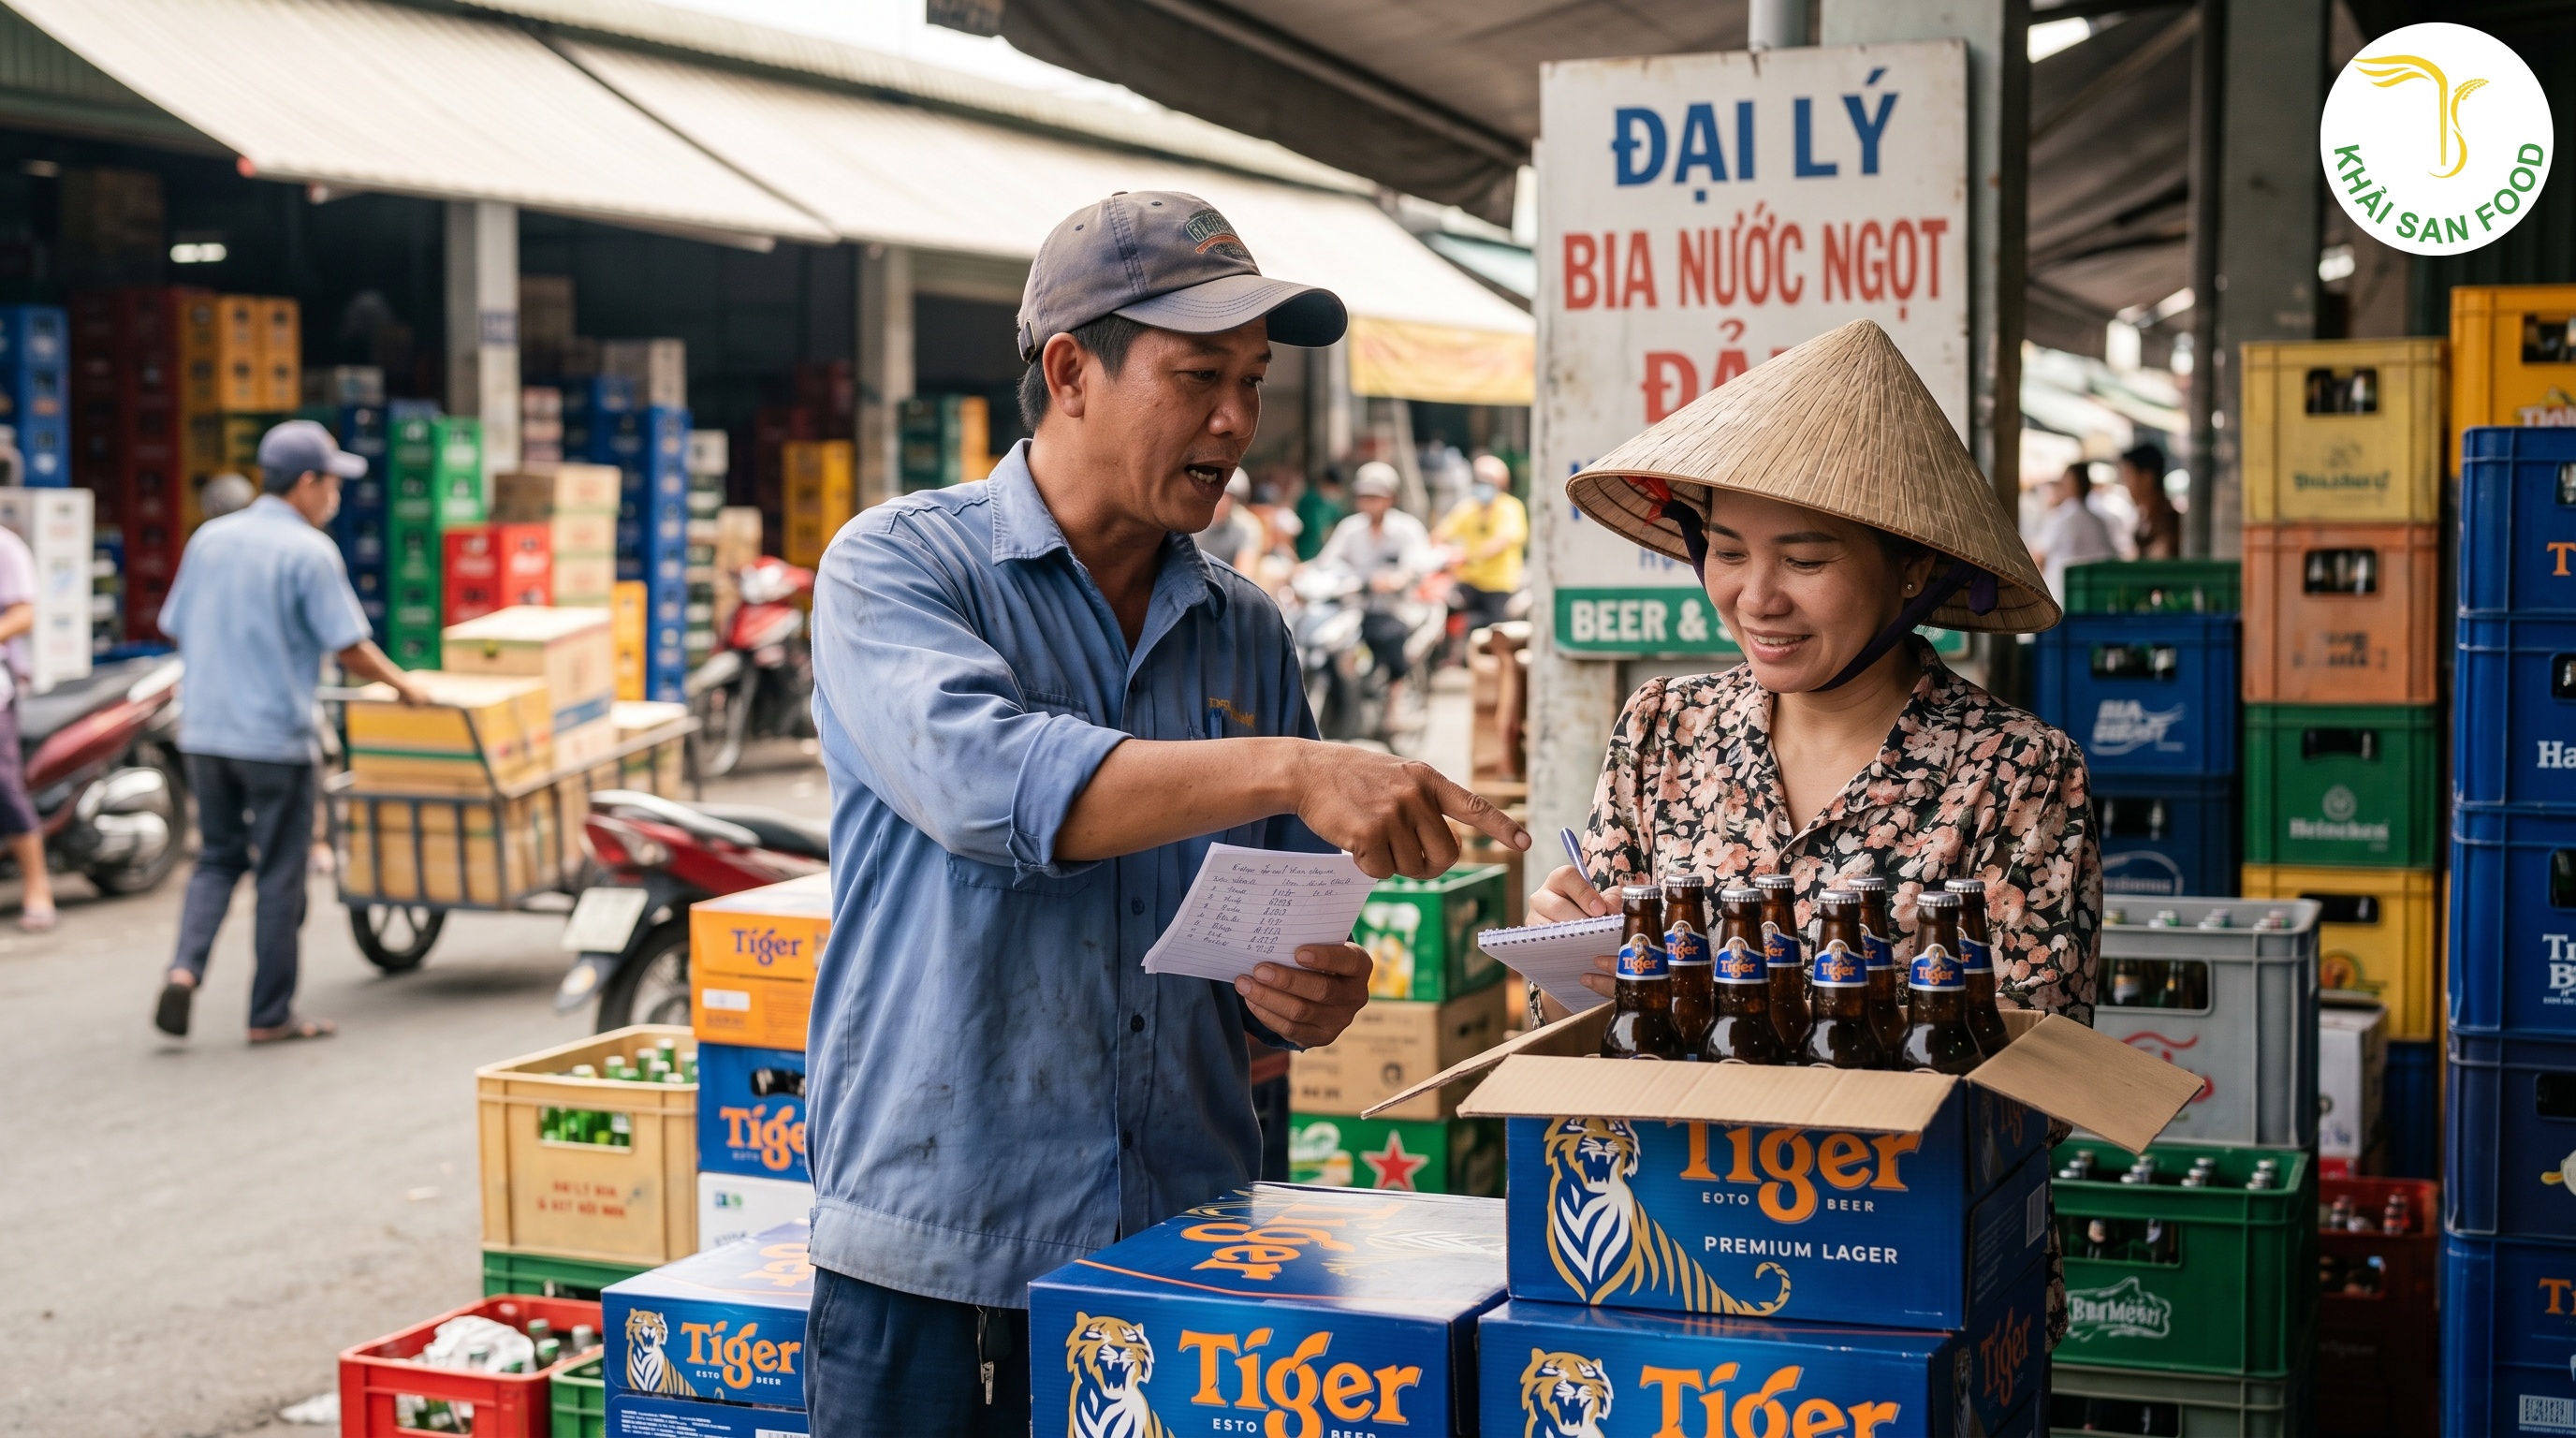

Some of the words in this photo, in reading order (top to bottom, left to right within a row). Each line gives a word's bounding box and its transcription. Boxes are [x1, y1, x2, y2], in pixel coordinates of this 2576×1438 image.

[1610, 100, 1756, 202] ĐẠI
[1793, 67, 1899, 178] LÝ
[1563, 230, 1658, 310] BIA
[1679, 202, 1805, 308] NƯỚC
[1822, 218, 1949, 322] NGỌT
[1641, 317, 1792, 425] ĐẢ
[1571, 599, 1668, 642] BEER
[1677, 598, 1709, 642] &
[731, 927, 803, 966] Tiger
[1764, 943, 1785, 961] ger
[1720, 958, 1756, 978] Tiger
[1822, 961, 1856, 982] Tiger
[1917, 965, 1954, 986] Tiger
[719, 1103, 806, 1171] Tige
[1666, 1120, 1923, 1225] Tiger
[1702, 1192, 1750, 1206] EOTO
[1826, 1198, 1875, 1212] BEER
[1705, 1236, 1812, 1258] PREMIUM
[1822, 1243, 1898, 1265] LAGER
[681, 1320, 802, 1390] Tiger
[695, 1370, 720, 1380] ESTO
[1980, 1307, 2031, 1406] Tiger
[1178, 1328, 1423, 1438] Tiger
[1212, 1417, 1257, 1433] ESTO
